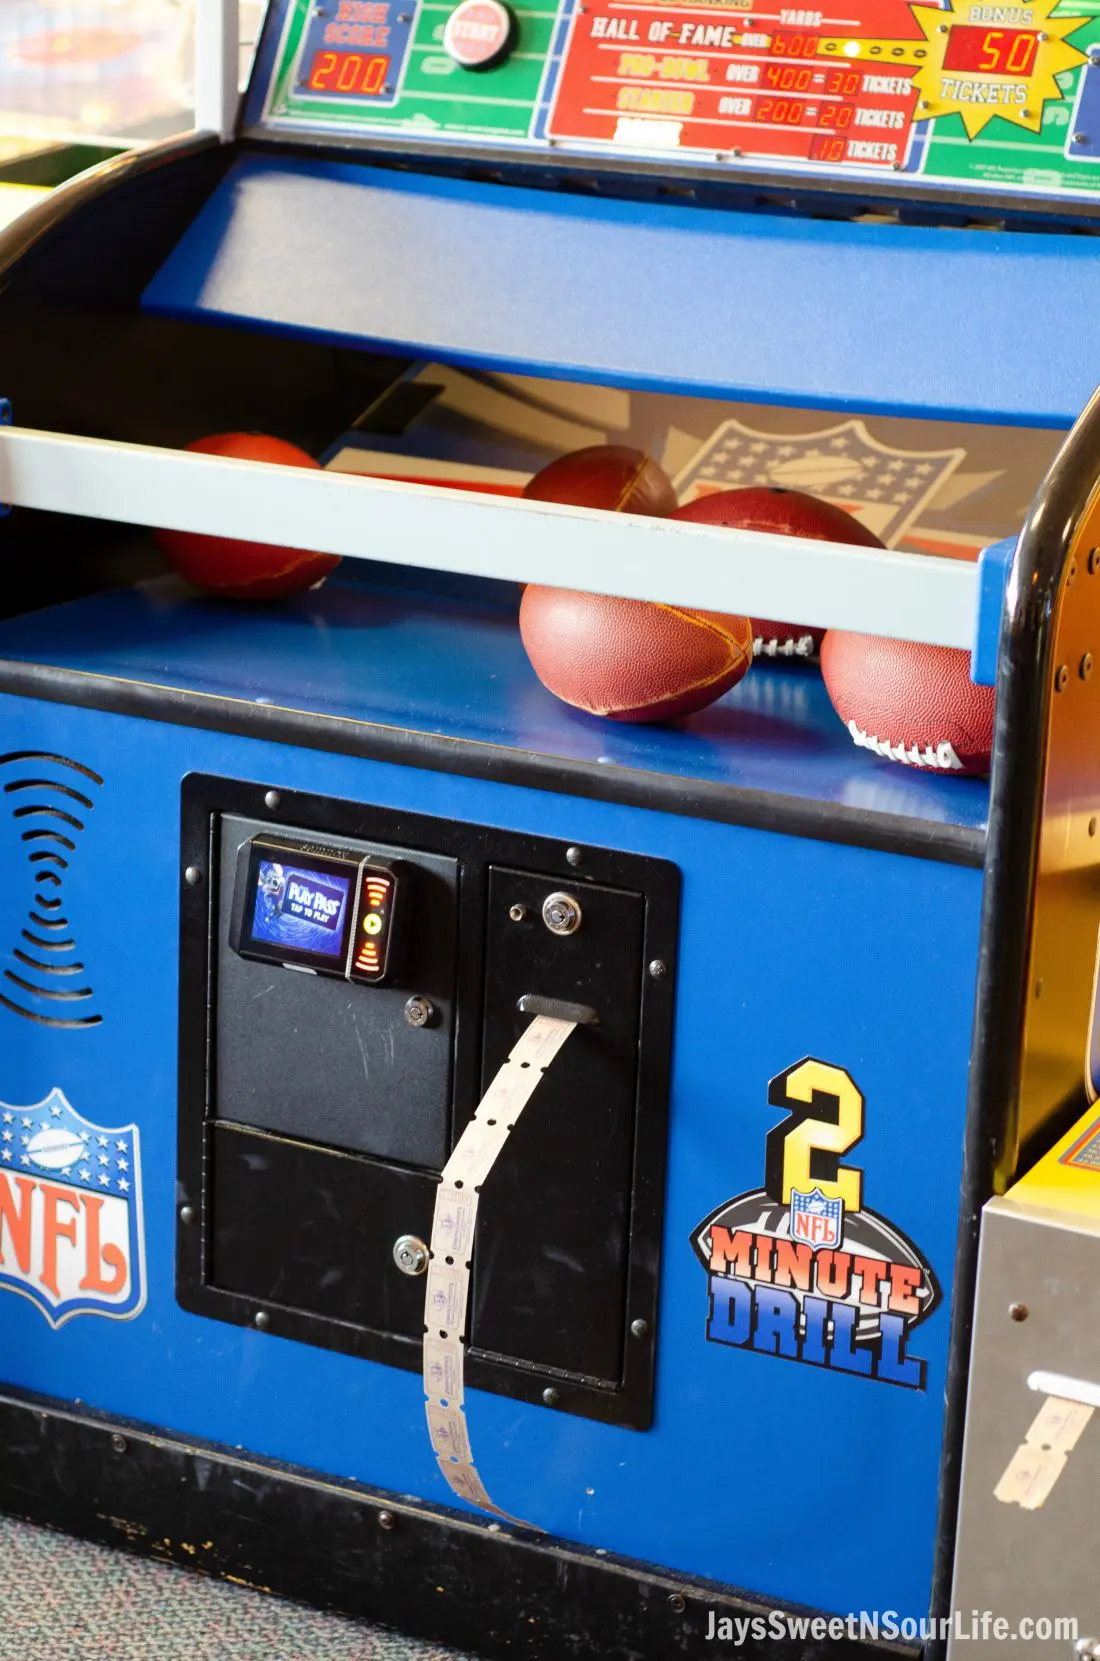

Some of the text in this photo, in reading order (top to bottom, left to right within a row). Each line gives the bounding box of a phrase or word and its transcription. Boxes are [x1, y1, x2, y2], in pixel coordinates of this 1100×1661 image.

[335, 1, 391, 24] HIGH
[969, 5, 1034, 25] BONUS
[323, 22, 392, 48] SCORE
[589, 16, 641, 41] HALL
[647, 20, 674, 42] OF
[678, 22, 737, 48] FAME
[771, 34, 819, 58] 600
[978, 31, 1036, 72] 50
[311, 53, 388, 93] 200
[725, 63, 760, 83] OVER
[767, 66, 812, 91] 400
[828, 72, 860, 95] 30
[861, 74, 913, 96] TICKETS
[940, 78, 1029, 104] TICKETS
[717, 96, 753, 117] OVER
[756, 99, 804, 124] 200
[819, 105, 853, 129] 20
[854, 107, 905, 130] TICKETS
[819, 139, 898, 162] 10 TICKETS
[288, 882, 341, 916] PLAY PASS
[290, 902, 330, 924] TAP TO PLAY
[781, 1059, 864, 1213] 2
[0, 1171, 127, 1299] NFL
[794, 1211, 836, 1243] NFL
[709, 1224, 922, 1316] MINUTE
[707, 1274, 925, 1388] DRILL
